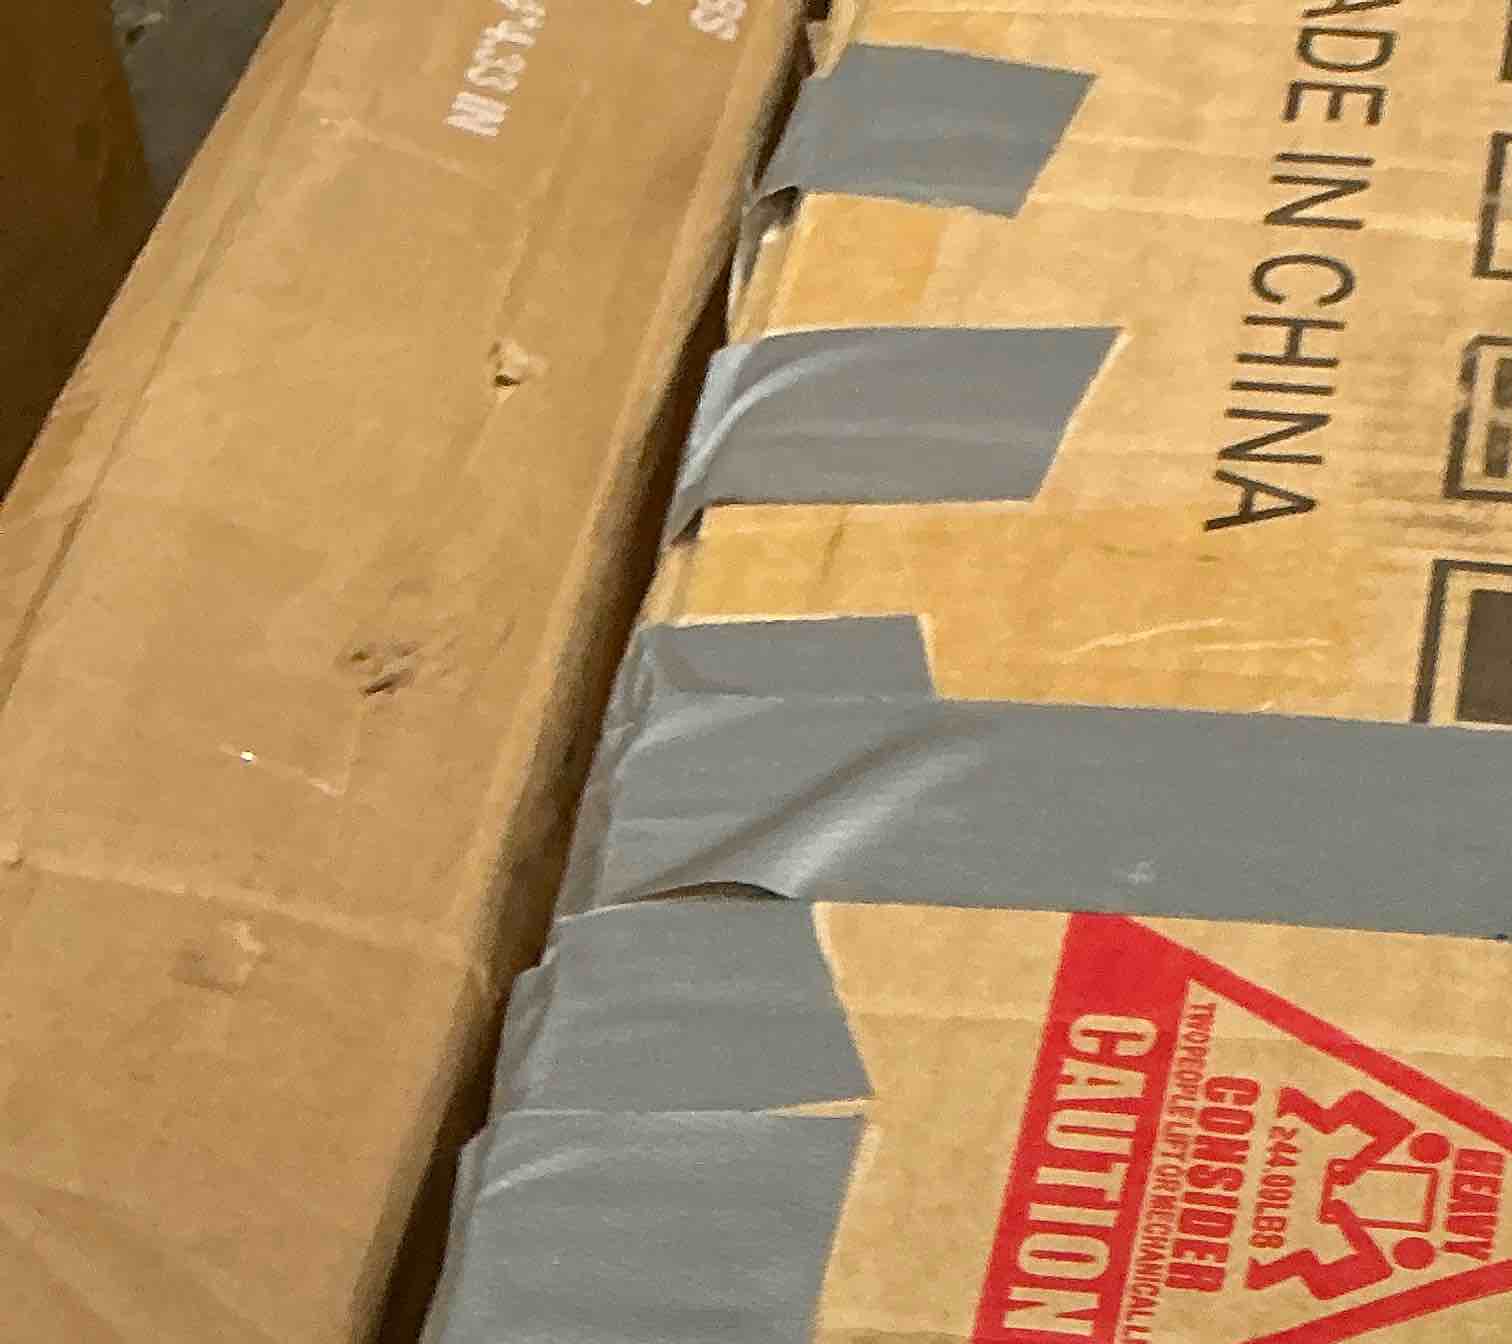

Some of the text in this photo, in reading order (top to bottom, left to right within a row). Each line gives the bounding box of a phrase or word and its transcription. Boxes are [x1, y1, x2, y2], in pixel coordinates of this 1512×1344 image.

[1263, 150, 1375, 231] IN
[1203, 253, 1356, 531] CHINA
[1003, 1014, 1158, 1337] CAUTION
[1152, 1164, 1184, 1192] OR
[1157, 1121, 1192, 1163] LIFT
[1164, 1076, 1262, 1293] CONSIDER
[1126, 1194, 1178, 1320] MECHANICAL
[1443, 1149, 1506, 1262] HEAVY
